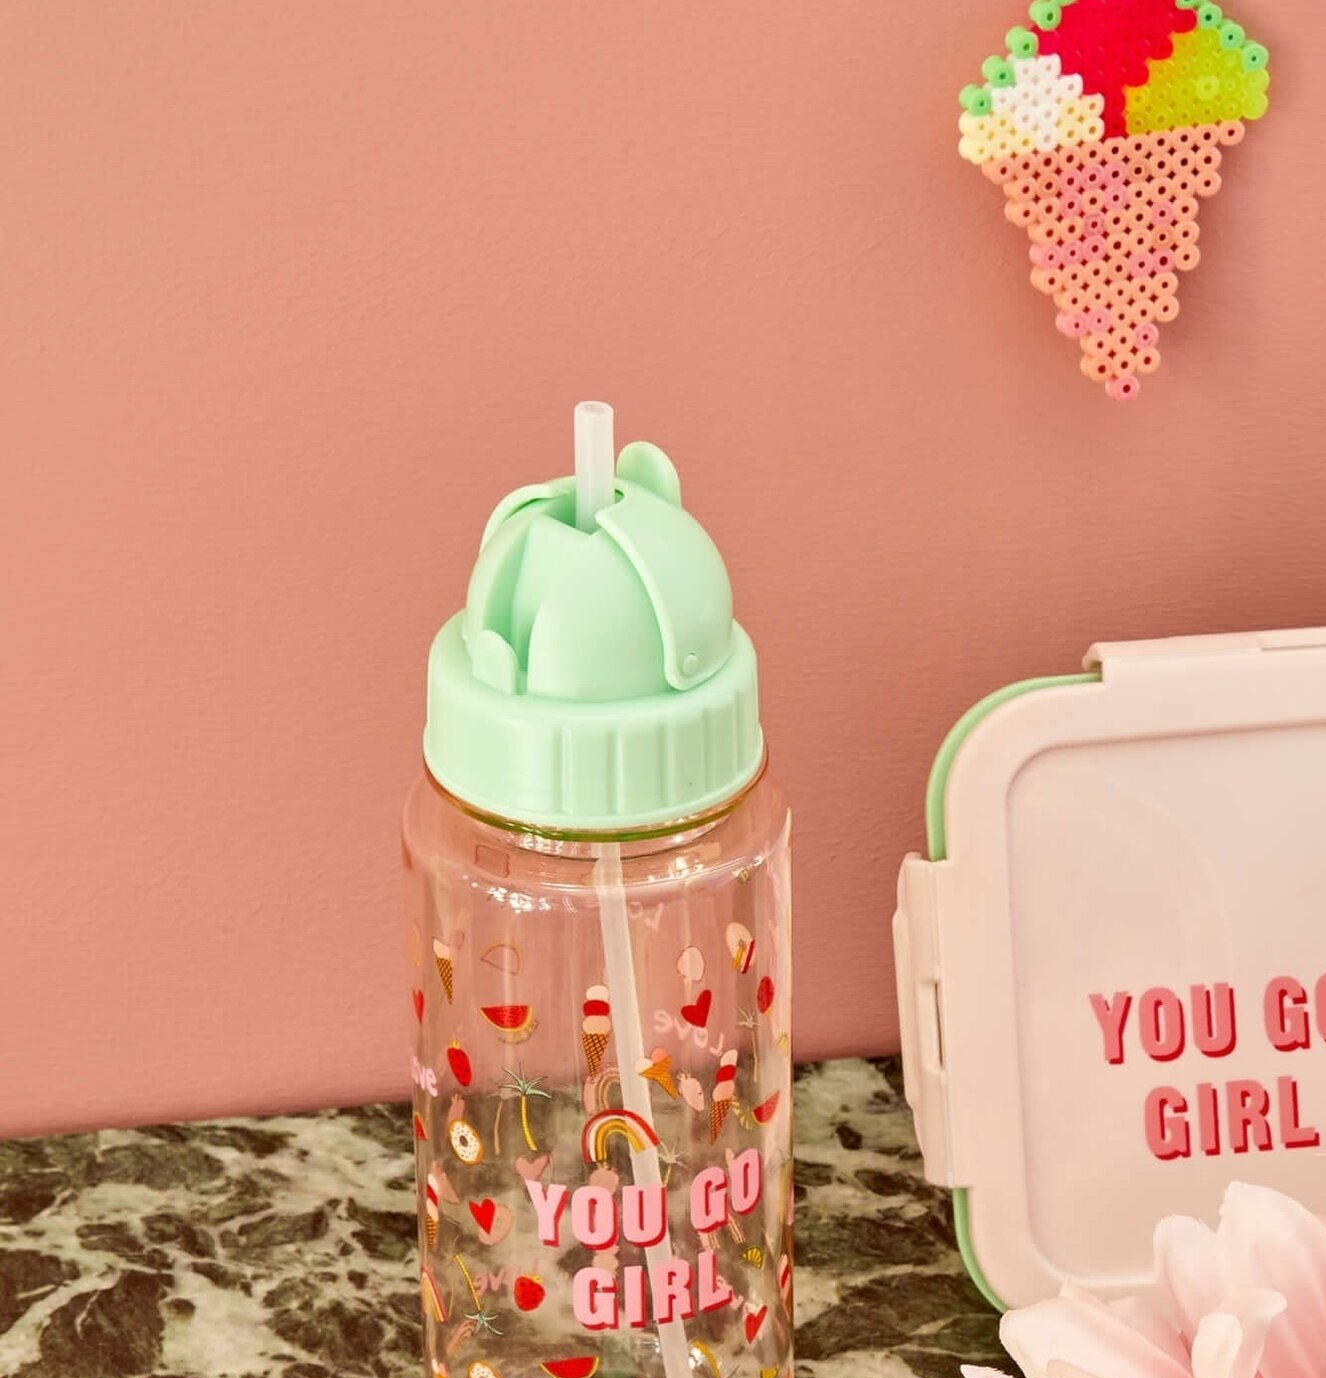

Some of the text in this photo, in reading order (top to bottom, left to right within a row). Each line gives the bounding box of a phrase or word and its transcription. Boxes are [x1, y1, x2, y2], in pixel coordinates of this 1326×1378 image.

[1088, 982, 1237, 1065] YOU
[1144, 1075, 1320, 1161] GIRL
[525, 1148, 762, 1251] YOU GO
[572, 1250, 733, 1331] GIRL
